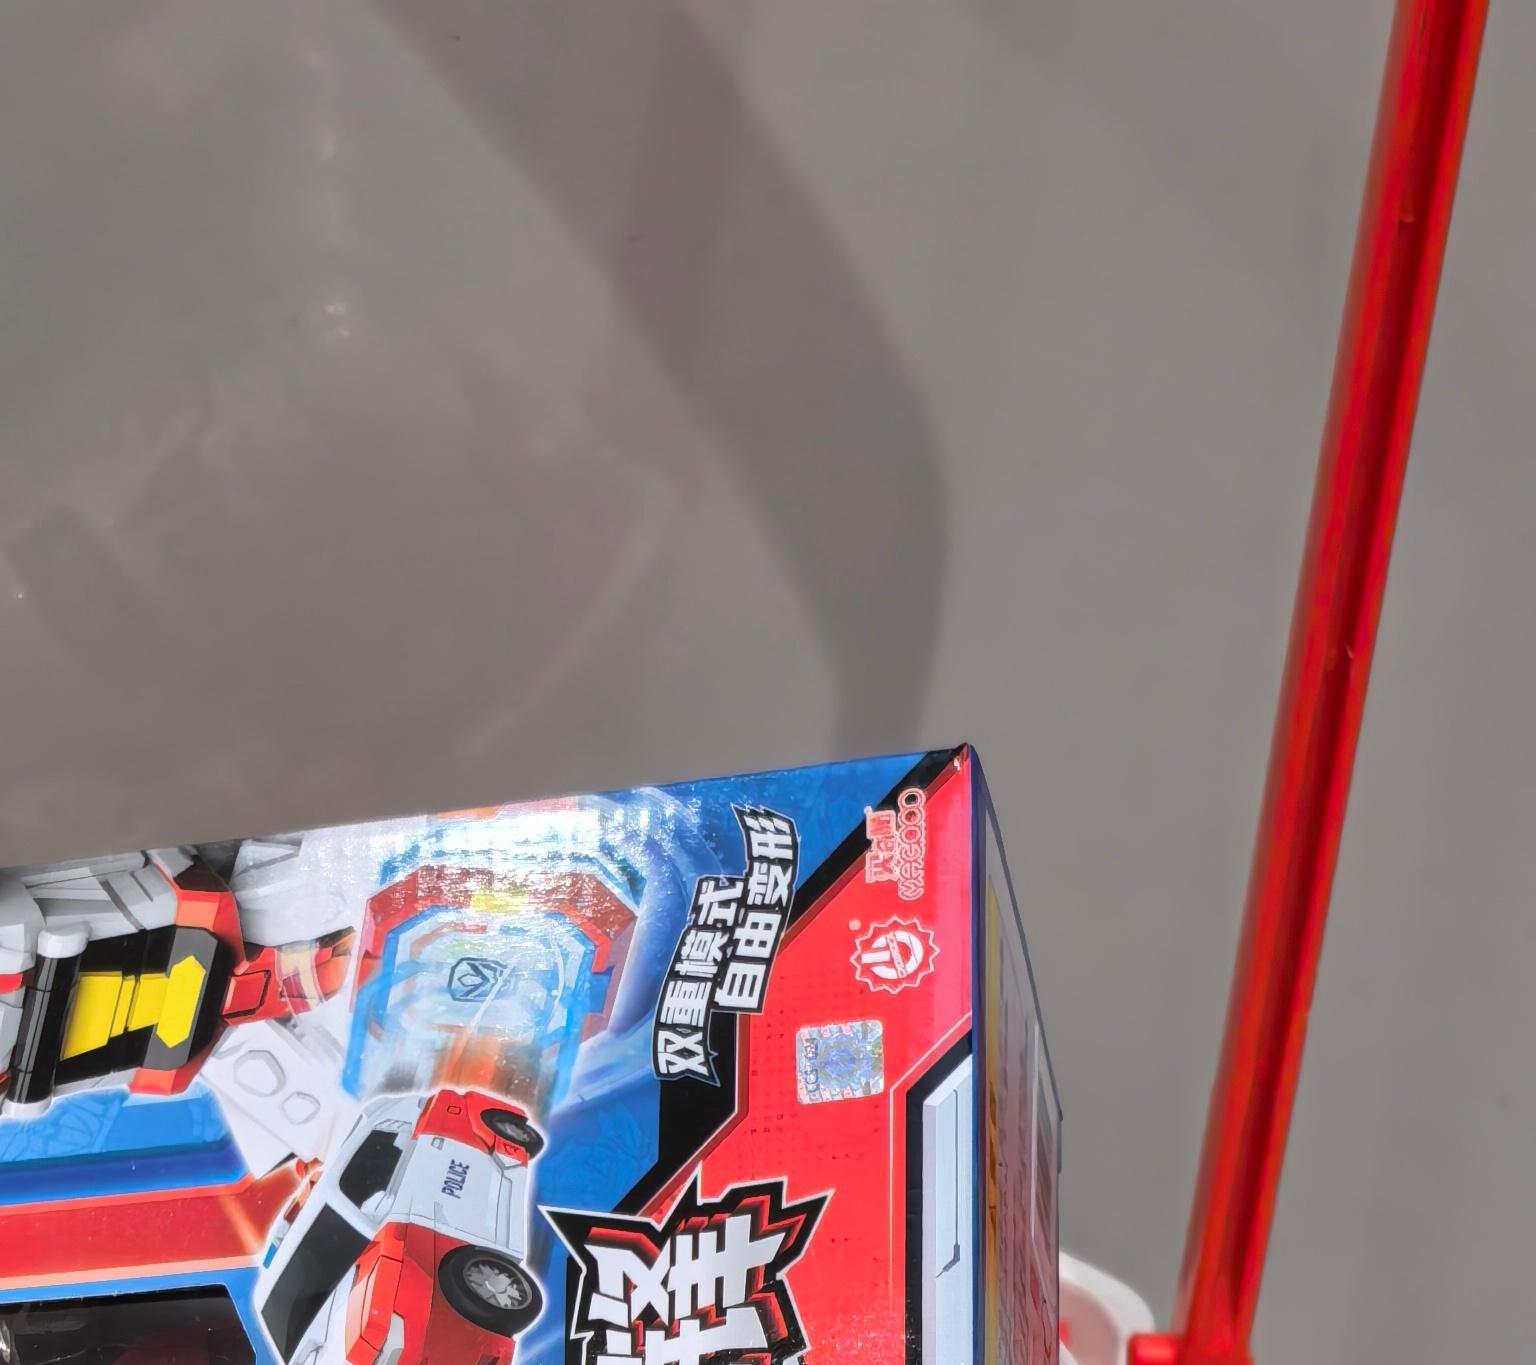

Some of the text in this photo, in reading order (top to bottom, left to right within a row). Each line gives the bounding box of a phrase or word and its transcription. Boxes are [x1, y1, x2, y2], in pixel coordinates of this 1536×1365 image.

[657, 875, 746, 1077] 双重模式
[718, 808, 796, 1012] 自由变形
[442, 1158, 470, 1200] POLICE
